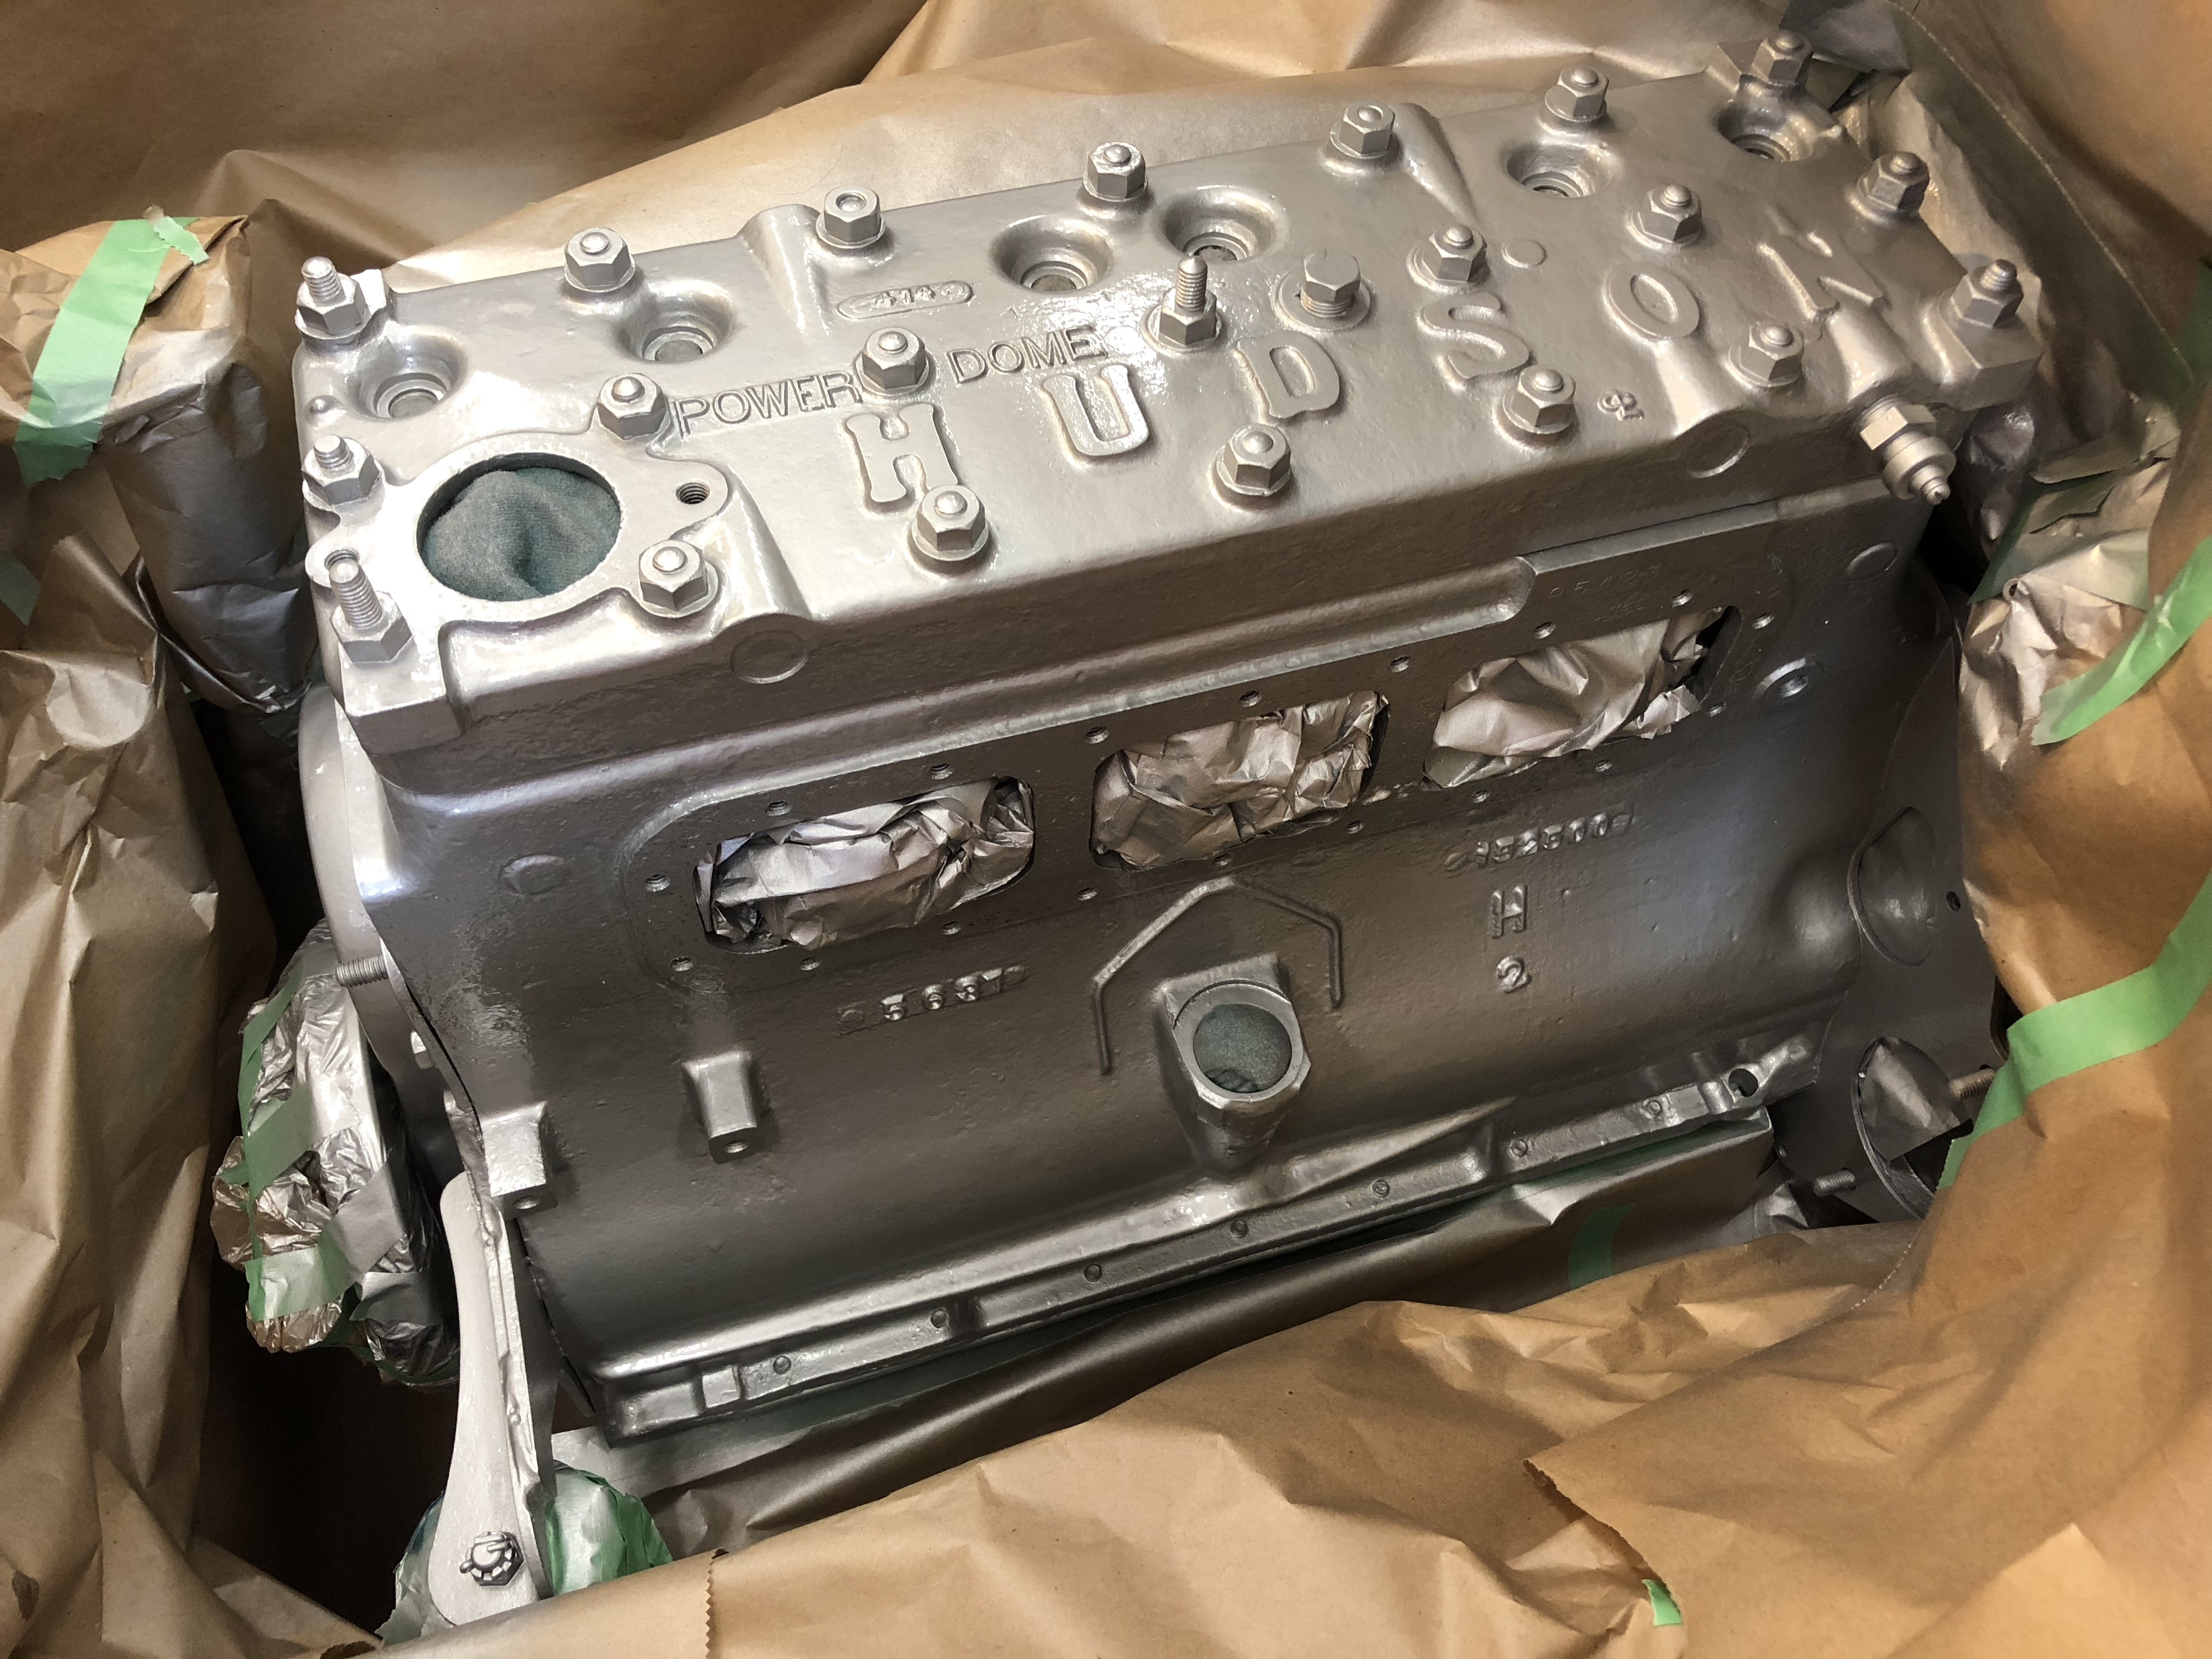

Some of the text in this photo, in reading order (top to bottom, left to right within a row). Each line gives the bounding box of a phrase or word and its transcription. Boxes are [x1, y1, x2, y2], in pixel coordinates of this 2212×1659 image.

[670, 325, 1108, 438] POWER DOME
[1489, 884, 1529, 939] H
[1496, 956, 1532, 994] 2
